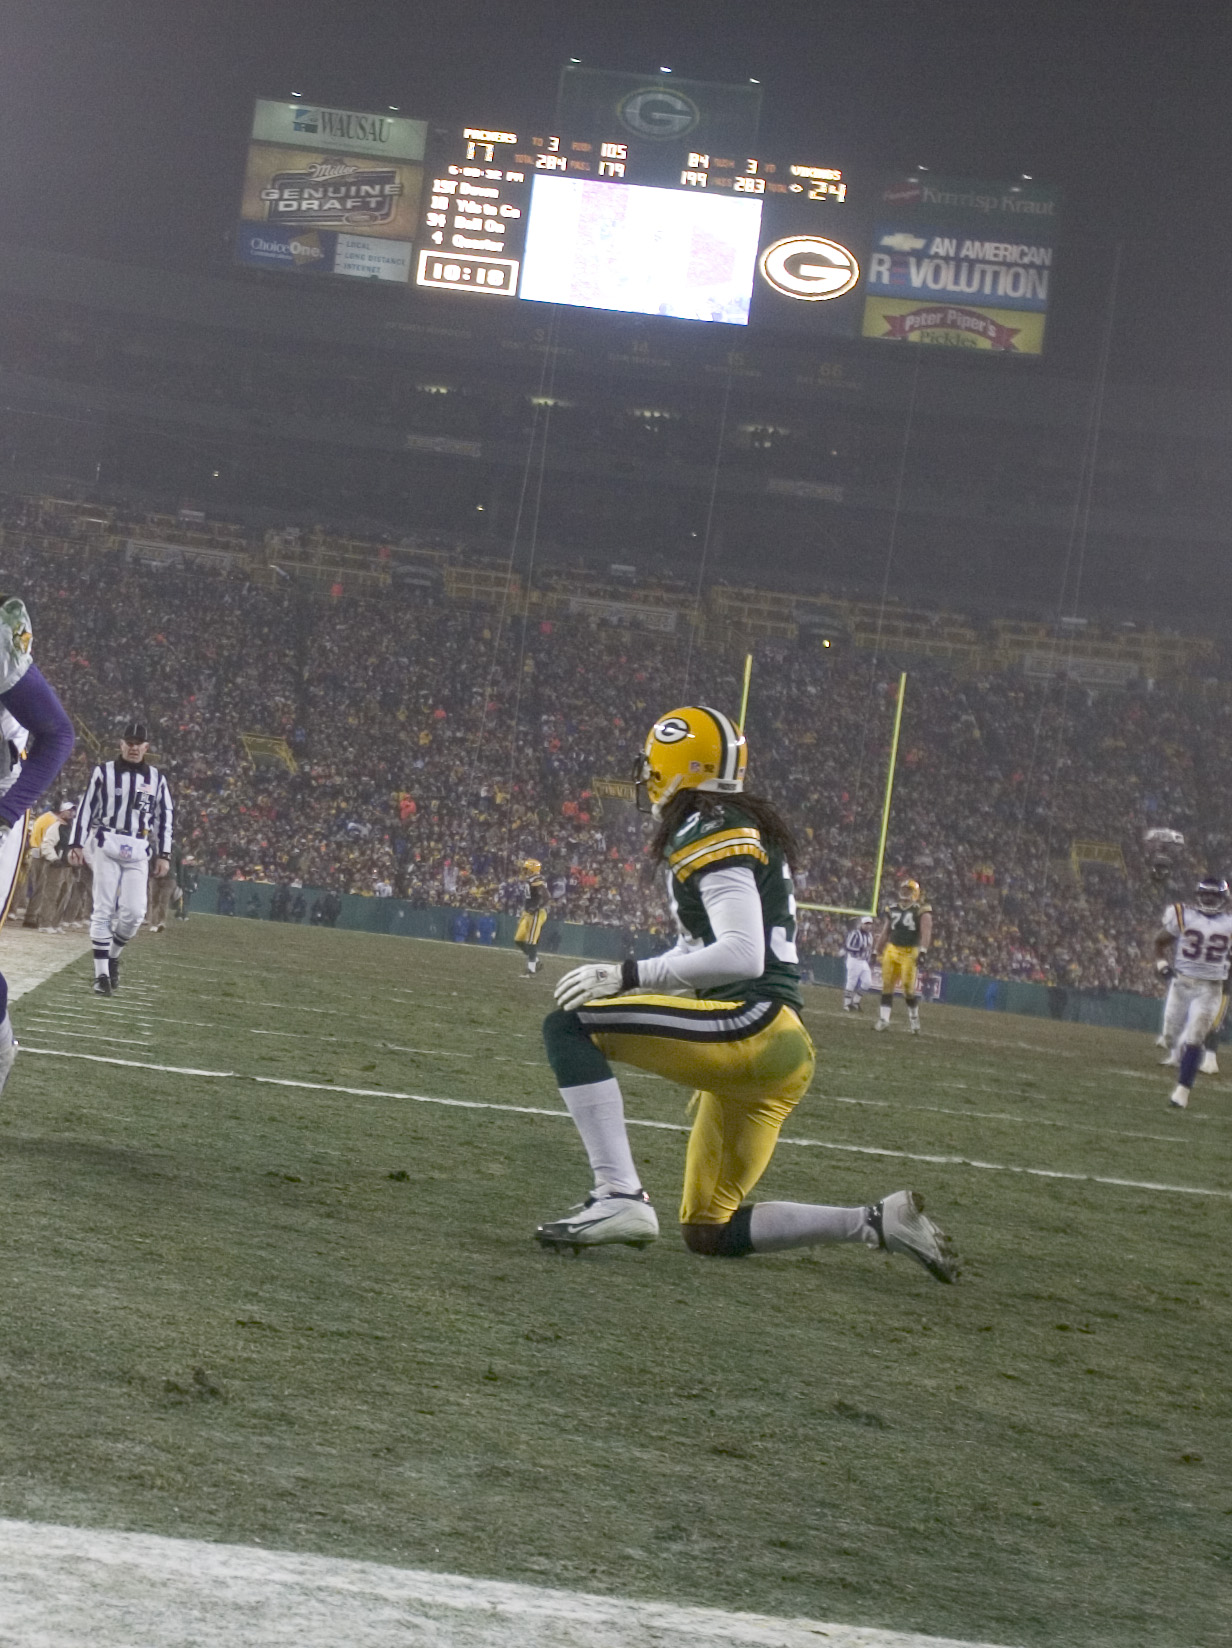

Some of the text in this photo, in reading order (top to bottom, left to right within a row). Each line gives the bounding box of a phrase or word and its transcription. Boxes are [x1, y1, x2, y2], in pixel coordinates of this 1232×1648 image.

[321, 111, 391, 143] WAUSAU
[466, 141, 495, 162] 17
[548, 136, 560, 152] 3
[600, 142, 628, 160] 105
[307, 163, 358, 182] Miller
[535, 154, 567, 172] 284
[598, 161, 626, 178] 179
[688, 152, 710, 169] 84
[746, 158, 758, 175] 3
[790, 164, 842, 181] VIKINGS
[459, 182, 500, 199] Down
[680, 170, 708, 188] 199
[733, 176, 766, 194] 283
[808, 180, 847, 203] 24
[261, 184, 402, 200] GENUINE
[278, 197, 383, 212] DRAFT
[1002, 196, 1055, 215] Kraut
[346, 241, 370, 250] LOCAL
[431, 230, 444, 245] 4
[345, 252, 406, 266] LONG DISTANCE
[930, 237, 1053, 266] AN AMERICAN
[344, 263, 381, 274] INTERNET
[432, 262, 505, 287] 10:18
[905, 309, 997, 337] Peter Piper's
[919, 330, 978, 348] Pickles
[891, 912, 916, 931] 74
[1182, 929, 1228, 963] 32
